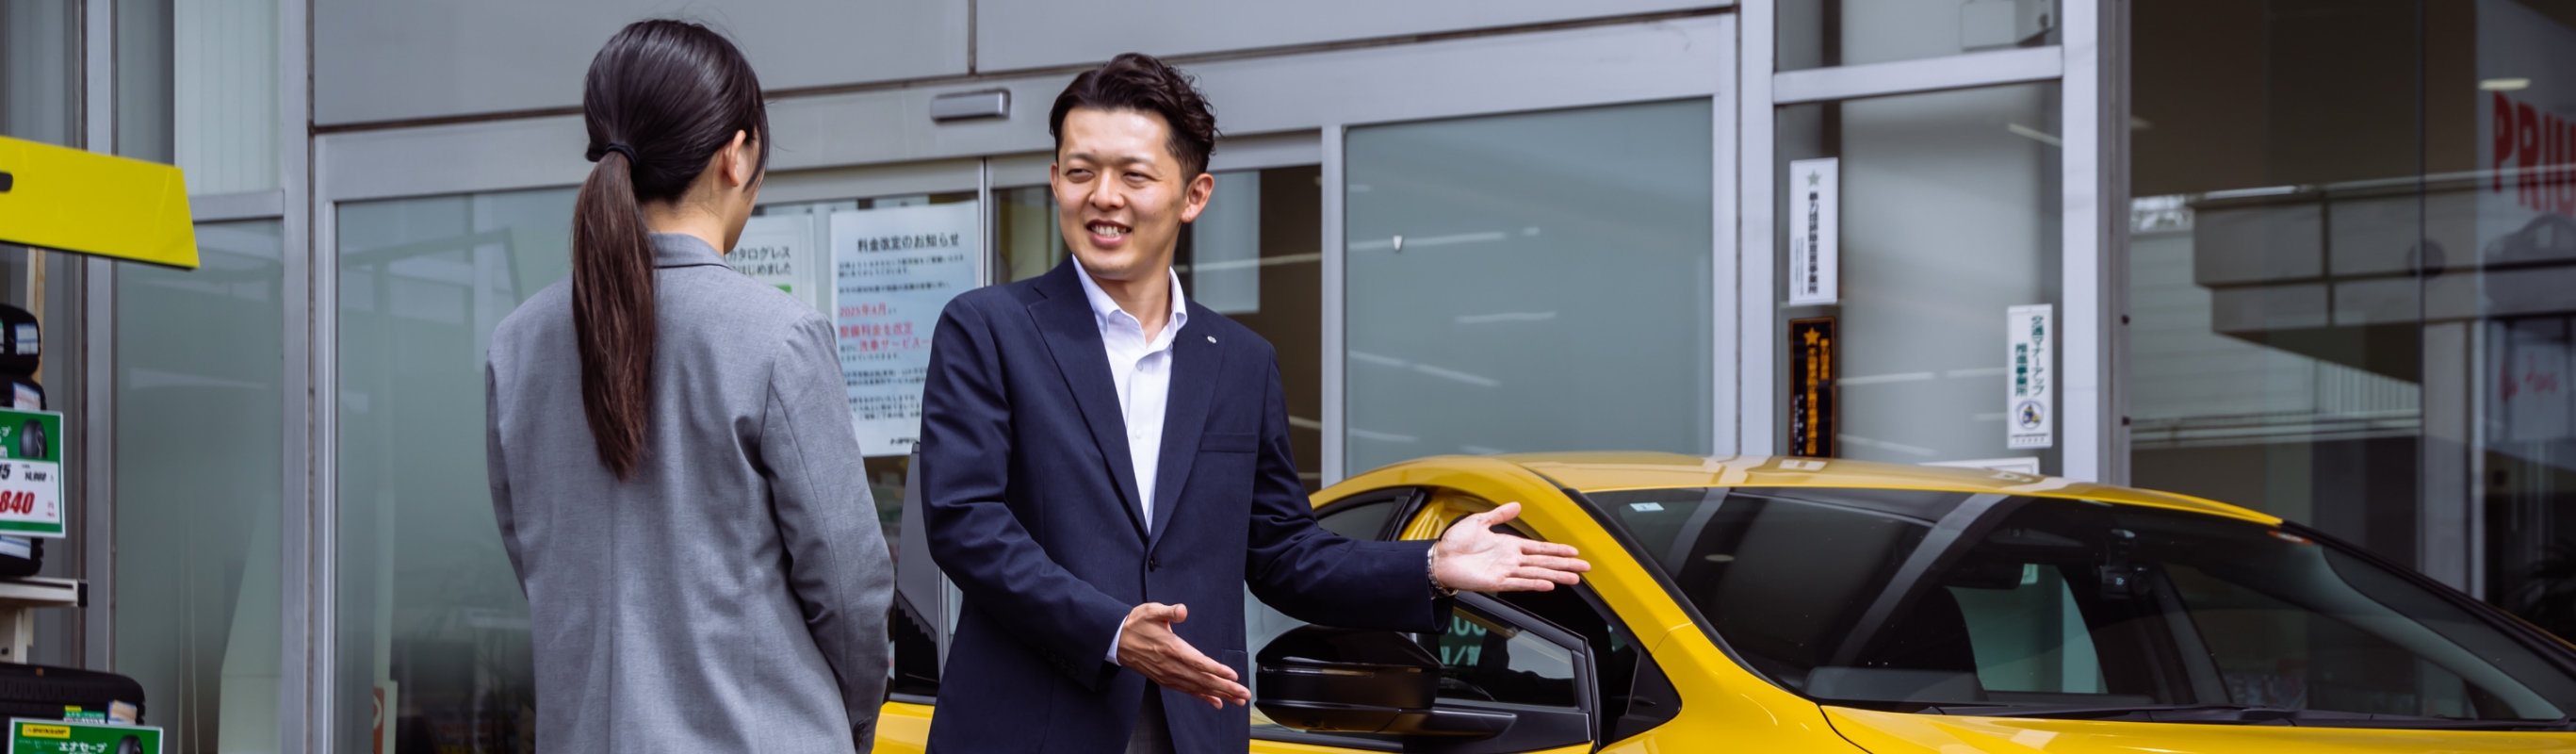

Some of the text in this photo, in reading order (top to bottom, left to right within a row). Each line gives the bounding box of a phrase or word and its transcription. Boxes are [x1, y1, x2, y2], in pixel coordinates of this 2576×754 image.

[857, 233, 959, 253] 料金改定のお知らせ
[2031, 316, 2045, 397] 交通マナーアップ
[2015, 343, 2028, 397] 推進事業所
[0, 490, 35, 516] 840
[58, 741, 107, 753] エナセーブ
